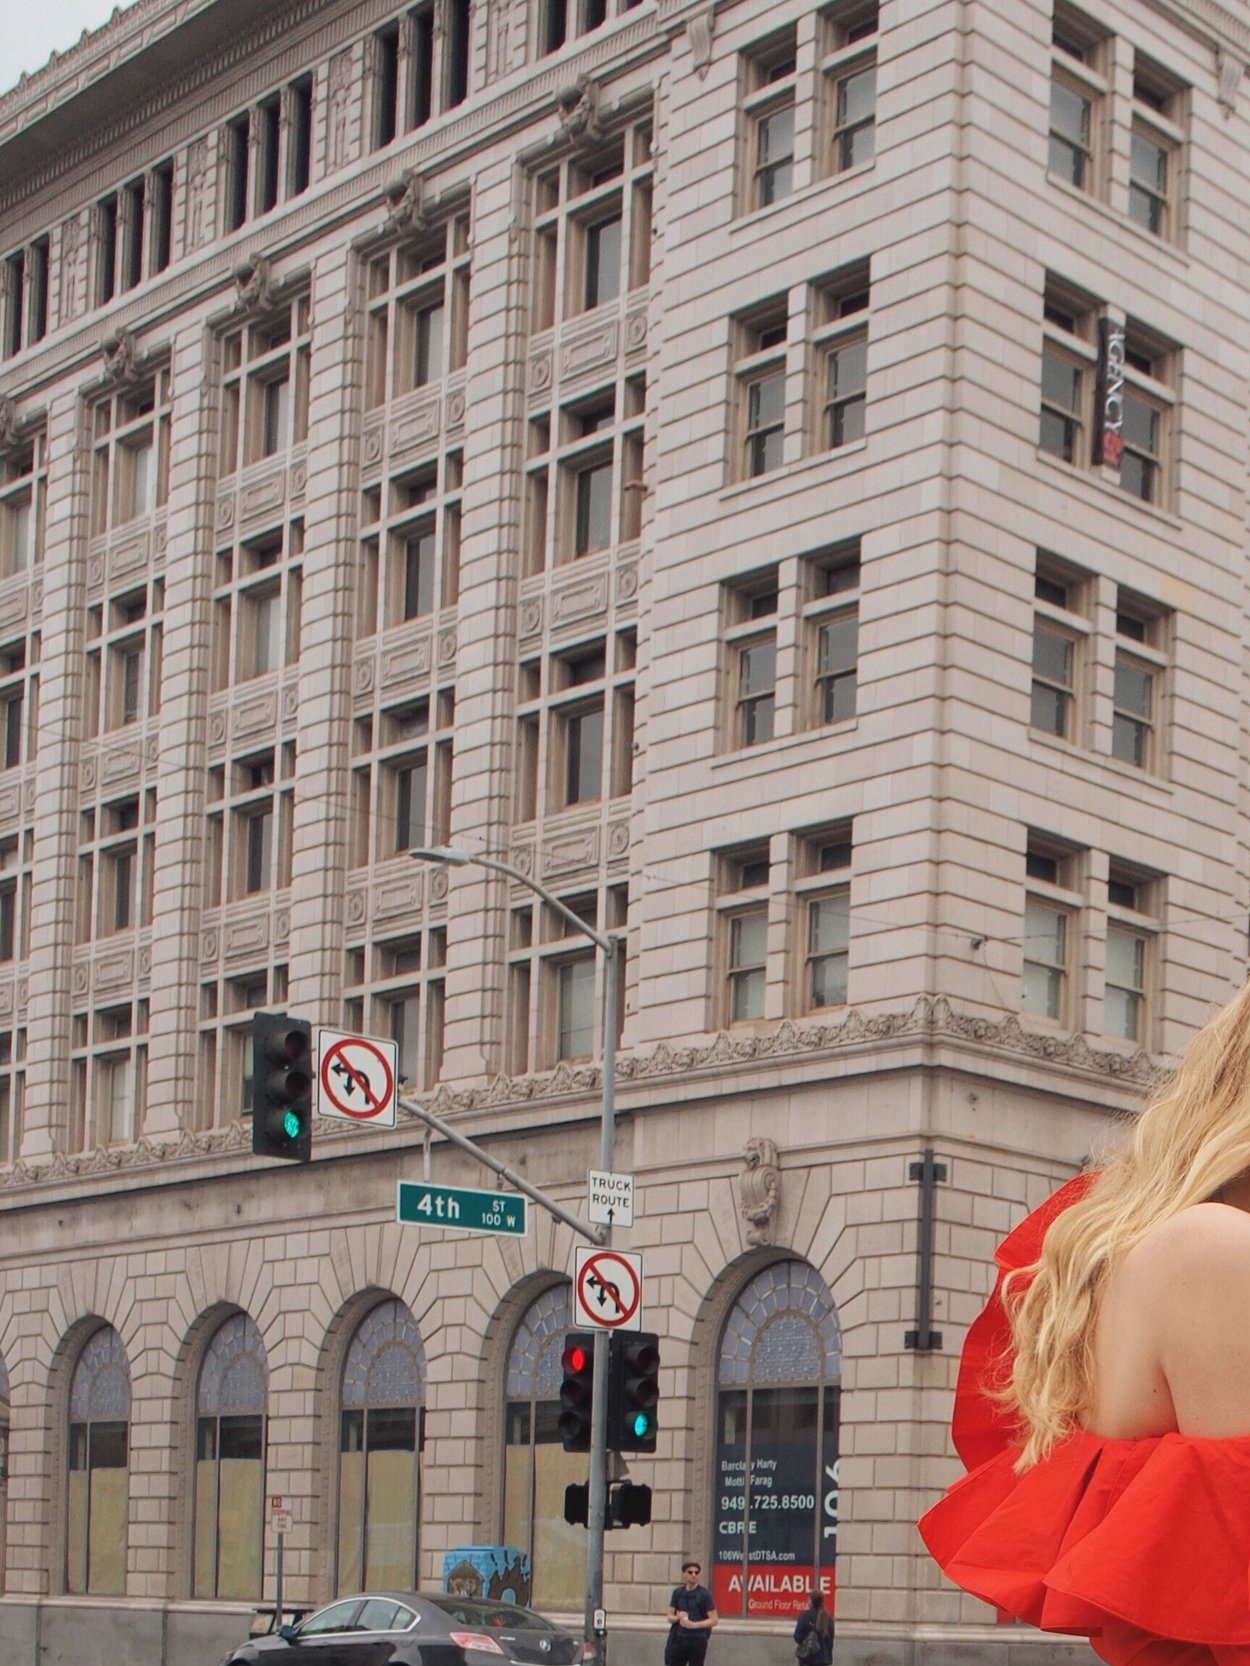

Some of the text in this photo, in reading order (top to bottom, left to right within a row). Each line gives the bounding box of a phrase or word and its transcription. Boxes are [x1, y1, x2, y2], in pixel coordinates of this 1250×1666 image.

[592, 1177, 631, 1192] TRUCK
[417, 1193, 505, 1219] 4th ST
[592, 1193, 630, 1208] ROUTE
[482, 1213, 516, 1227] 100 W
[756, 1459, 777, 1471] Harty
[750, 1475, 773, 1488] Farag
[721, 1495, 815, 1510] 949.725.8500
[728, 1574, 831, 1594] AVAILABLE
[748, 1599, 773, 1609] Ground
[774, 1600, 791, 1610] Floor
